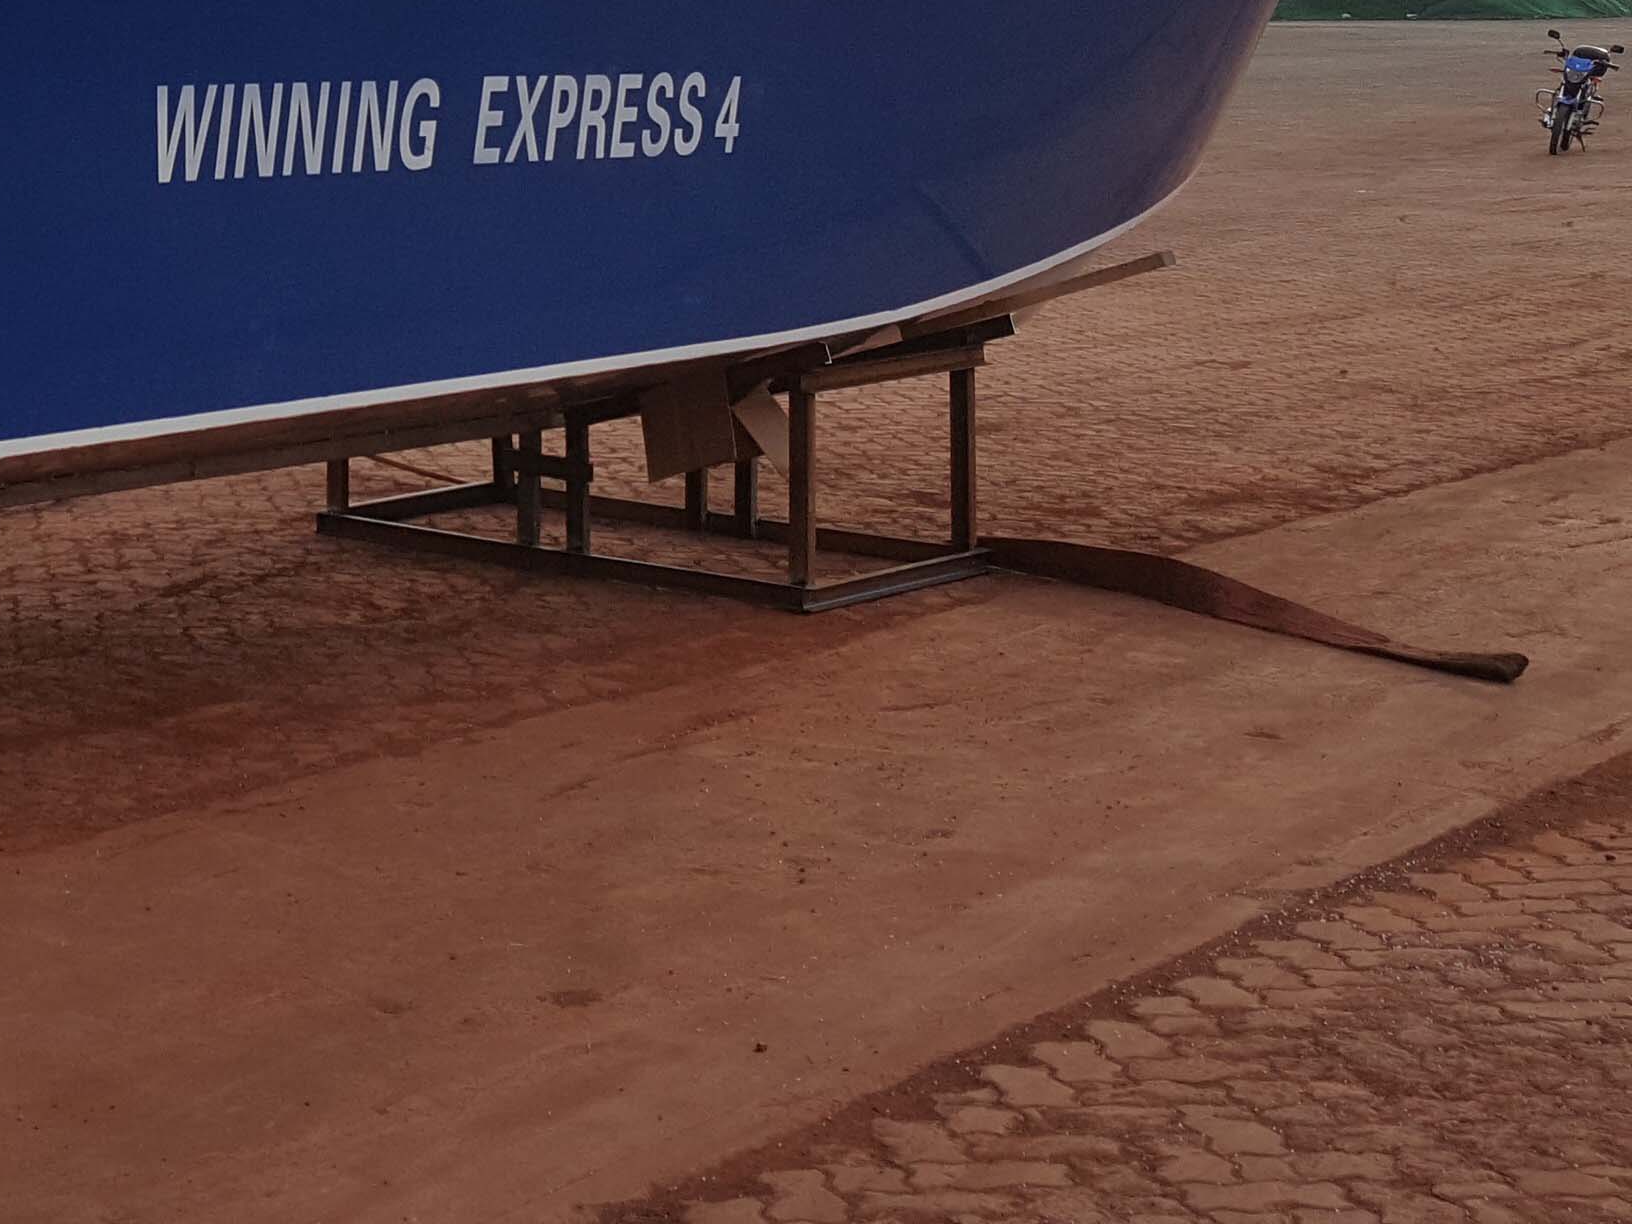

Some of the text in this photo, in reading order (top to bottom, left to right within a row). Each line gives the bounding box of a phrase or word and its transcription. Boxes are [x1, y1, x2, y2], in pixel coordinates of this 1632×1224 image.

[157, 72, 742, 183] WINNING EXPRESS 4
